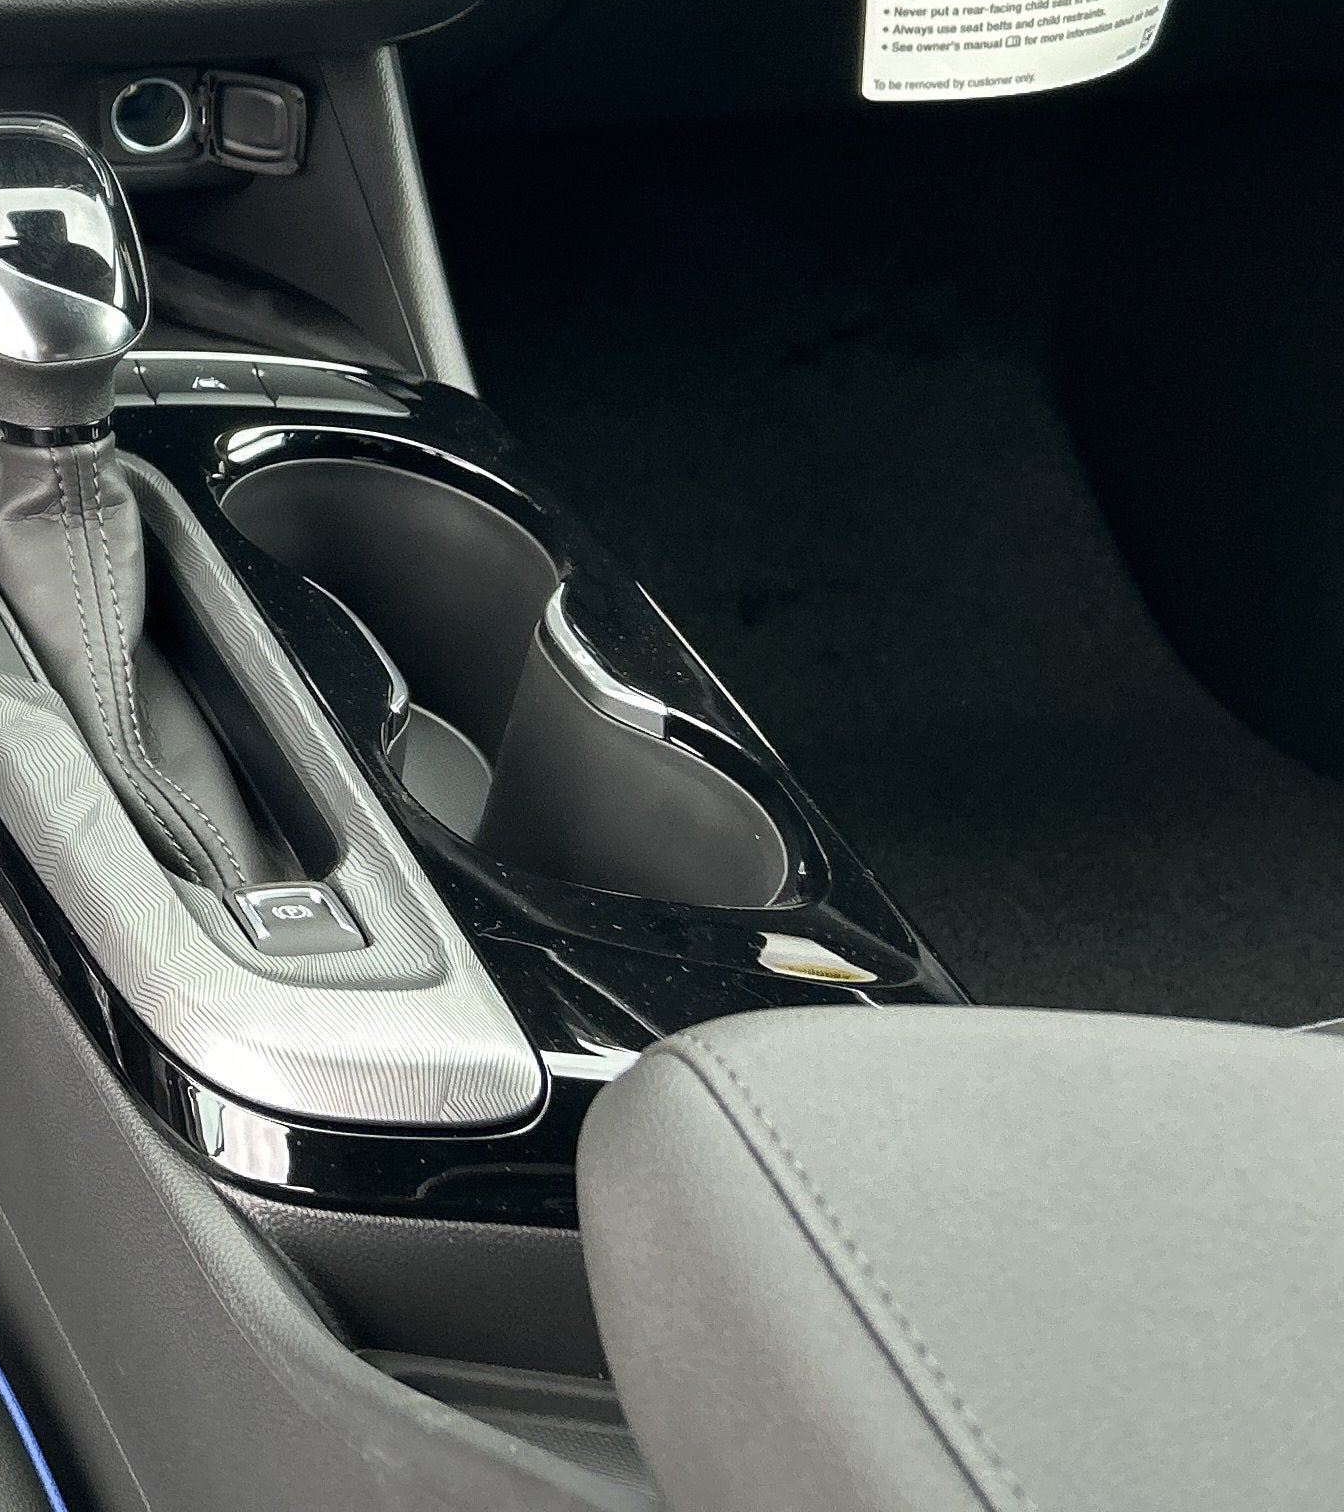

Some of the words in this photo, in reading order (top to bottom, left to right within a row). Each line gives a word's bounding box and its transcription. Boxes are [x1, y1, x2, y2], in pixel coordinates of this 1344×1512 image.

[894, 6, 928, 17] Never
[930, 6, 949, 18] put
[952, 7, 959, 16] a
[962, 3, 1023, 15] rear-facing
[1025, 0, 1050, 11] child
[892, 23, 934, 36] Always
[937, 25, 957, 34] use
[959, 22, 983, 33] seat
[986, 21, 1013, 32] belts
[1015, 18, 1035, 29] and
[1037, 15, 1061, 27] child
[892, 41, 913, 52] See
[916, 41, 961, 52] owner's
[963, 38, 1003, 50] manual
[1024, 35, 1038, 45] for
[1040, 32, 1064, 44] more
[1066, 23, 1113, 39] information
[873, 78, 886, 91] To
[888, 79, 902, 90] be
[904, 78, 950, 89] removed
[952, 78, 965, 91] by
[967, 75, 1013, 88] customer
